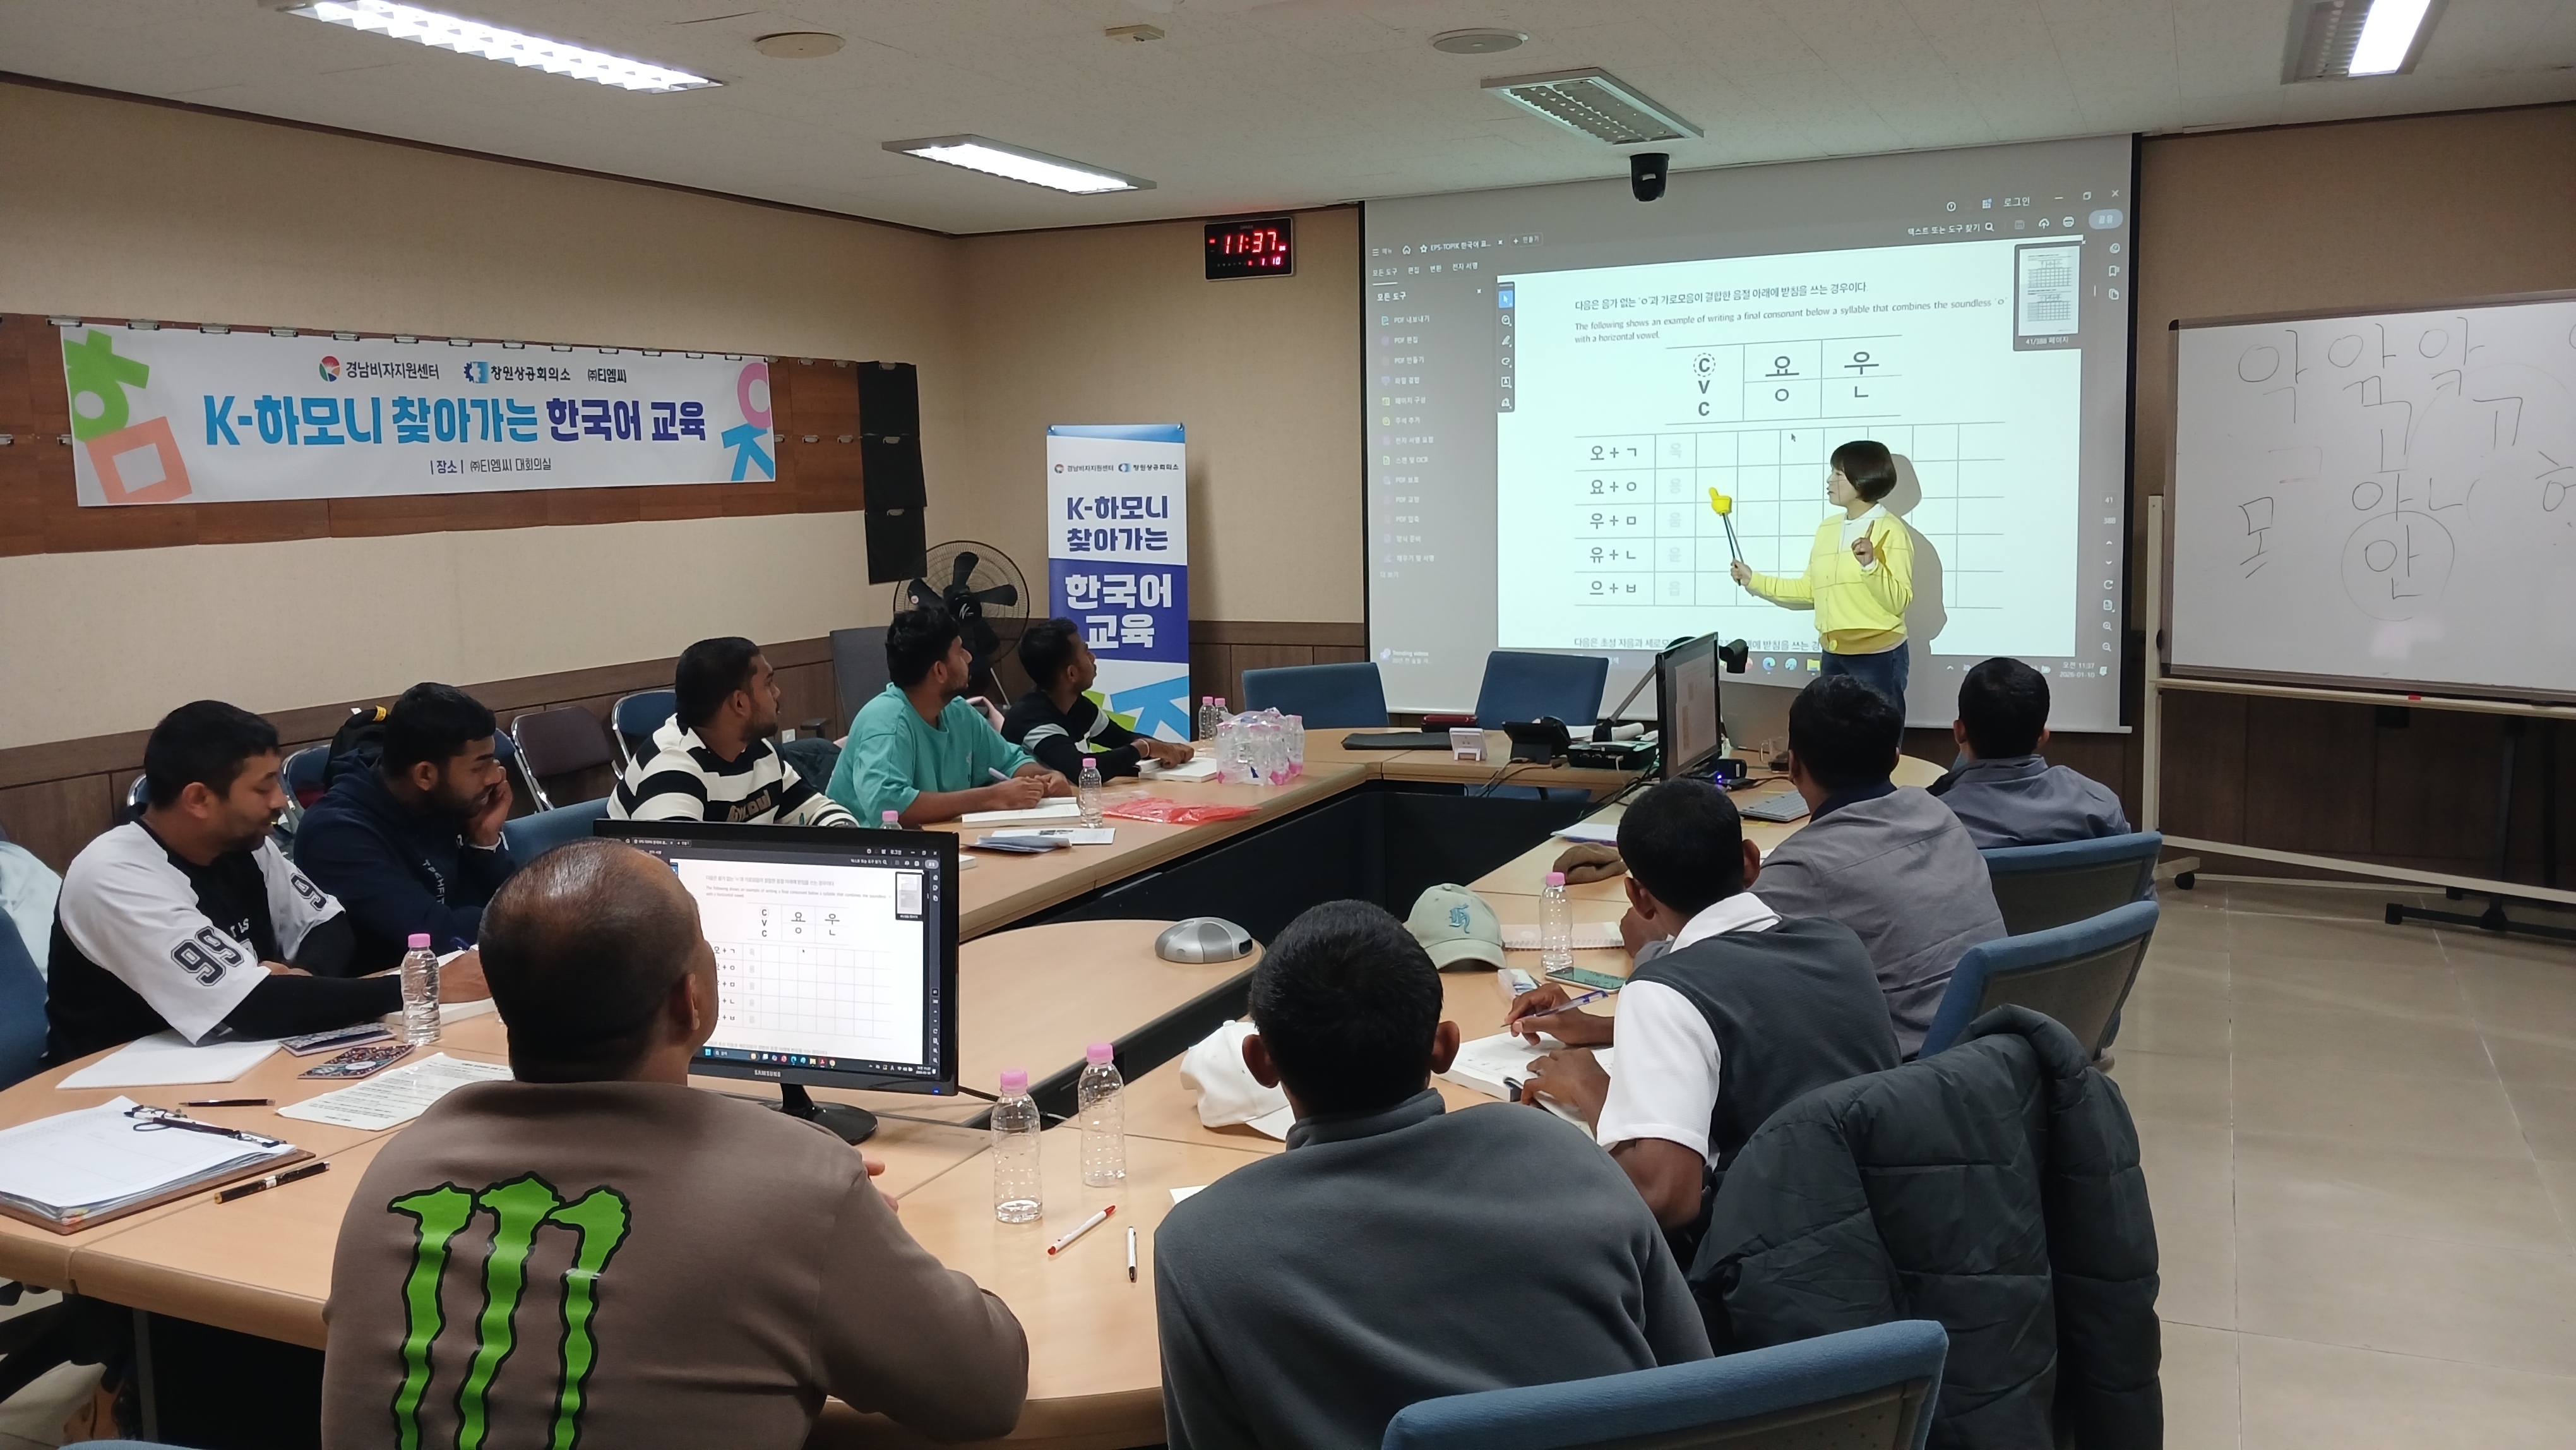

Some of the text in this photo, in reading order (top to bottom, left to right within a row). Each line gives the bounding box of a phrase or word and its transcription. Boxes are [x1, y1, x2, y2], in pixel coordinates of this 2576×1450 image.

[2003, 197, 2030, 207] 로그인
[1908, 224, 1980, 236] 텍스트 또는 도구 찾기
[1225, 231, 1277, 255] 11:37
[1431, 243, 1460, 251] EPS-TOPIK
[1461, 241, 1479, 250] 한국어
[1377, 292, 1407, 301] 모든 도구
[1575, 300, 1599, 311] 다음은
[1602, 299, 1618, 309] 음가
[1620, 297, 1636, 308] 없는
[1705, 291, 1731, 303] 결합한
[1733, 289, 1750, 301] 음절
[1753, 287, 1779, 299] 아래에
[1781, 285, 1807, 297] 받침을
[1810, 285, 1828, 295] 쓰는
[1591, 320, 1624, 329] following
[1626, 319, 1649, 328] shows
[1664, 316, 1695, 325] example
[1697, 315, 1705, 323] of
[1708, 314, 1734, 322] writing
[1744, 311, 1760, 320] final
[1763, 310, 1803, 319] consonant
[1806, 308, 1830, 316] below
[1840, 305, 1869, 315] syllable
[1892, 302, 1931, 311] combines
[1951, 299, 1991, 308] soundless
[1575, 335, 1590, 343] with
[1599, 332, 1635, 342] horizontal
[345, 361, 440, 380] 경남비자지원센터
[491, 365, 571, 382] 창원상공회의소
[1698, 357, 1710, 373] C
[1766, 352, 1879, 377] 요 우
[1698, 380, 1710, 394] V
[1698, 402, 1710, 417] C
[203, 395, 706, 446] K-하모니 찾아가는 한국어 교육
[515, 457, 552, 472] 대회의실
[1067, 496, 1168, 520] K-하모니
[1067, 527, 1168, 551] 찾아가는
[1065, 573, 1171, 609] 한국어
[1085, 614, 1154, 649] 교육
[1574, 637, 1597, 648] 다음은
[1619, 638, 1642, 648] 자음과
[1763, 640, 1789, 650] 받침을
[1792, 641, 1809, 650] 쓰는
[791, 912, 840, 925] 요 우
[170, 925, 245, 986] 99
[754, 1069, 781, 1077] SAMSUNG
